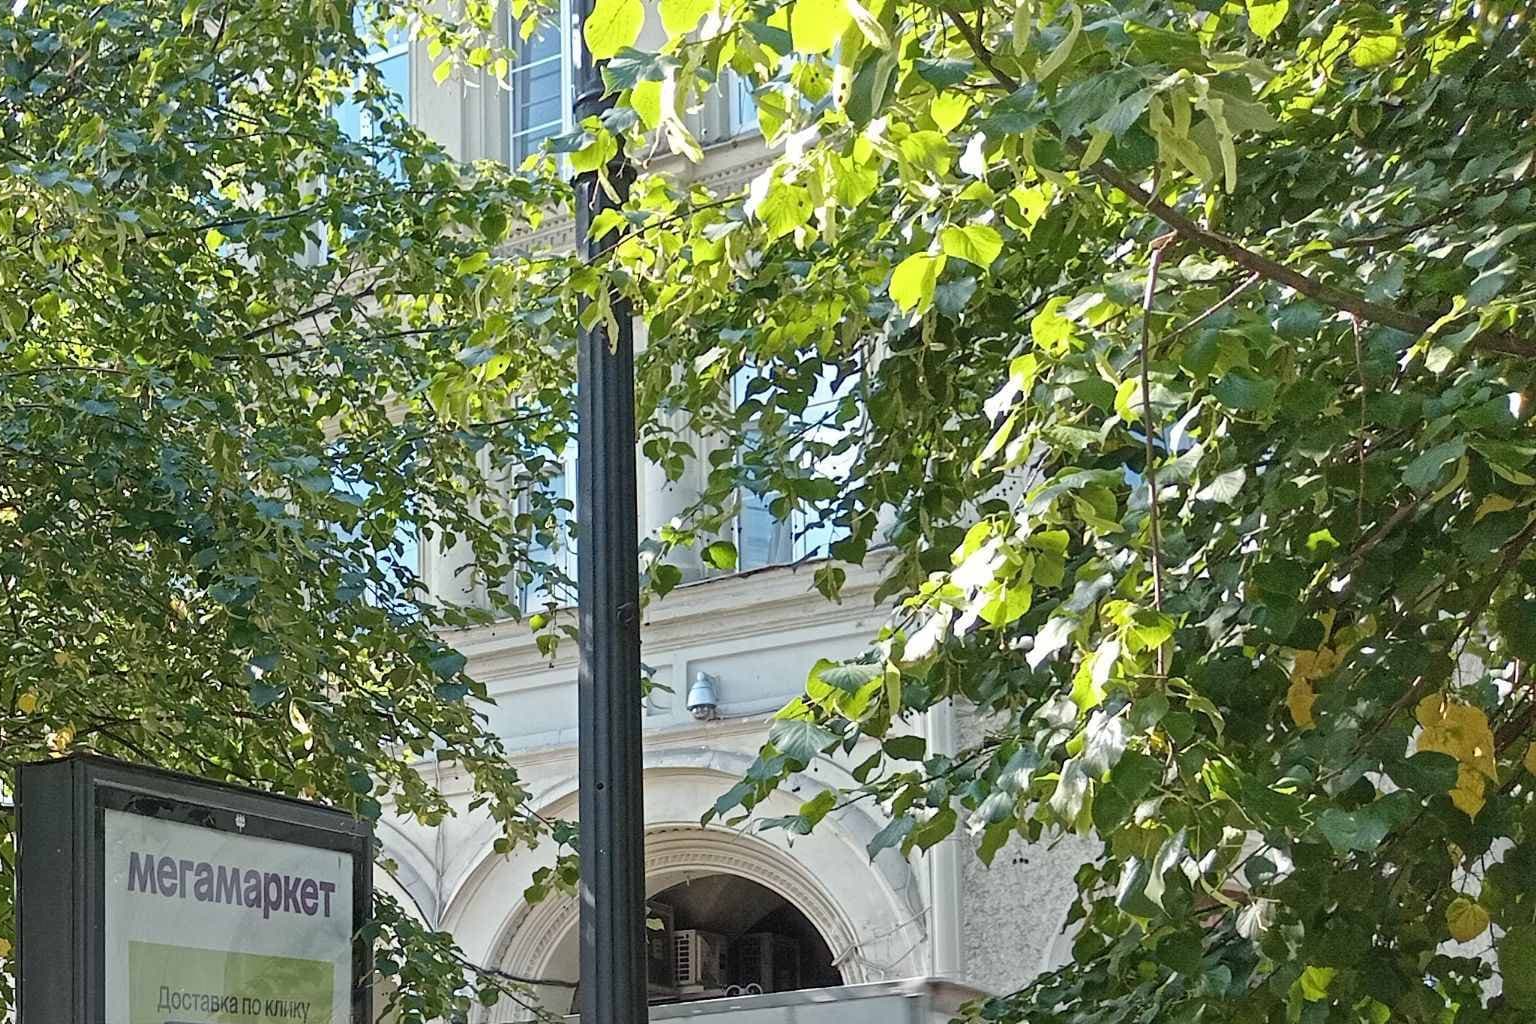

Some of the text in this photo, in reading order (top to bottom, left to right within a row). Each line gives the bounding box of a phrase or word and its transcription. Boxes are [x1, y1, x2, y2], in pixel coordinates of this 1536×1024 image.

[157, 985, 311, 1024] Доставка по клику
